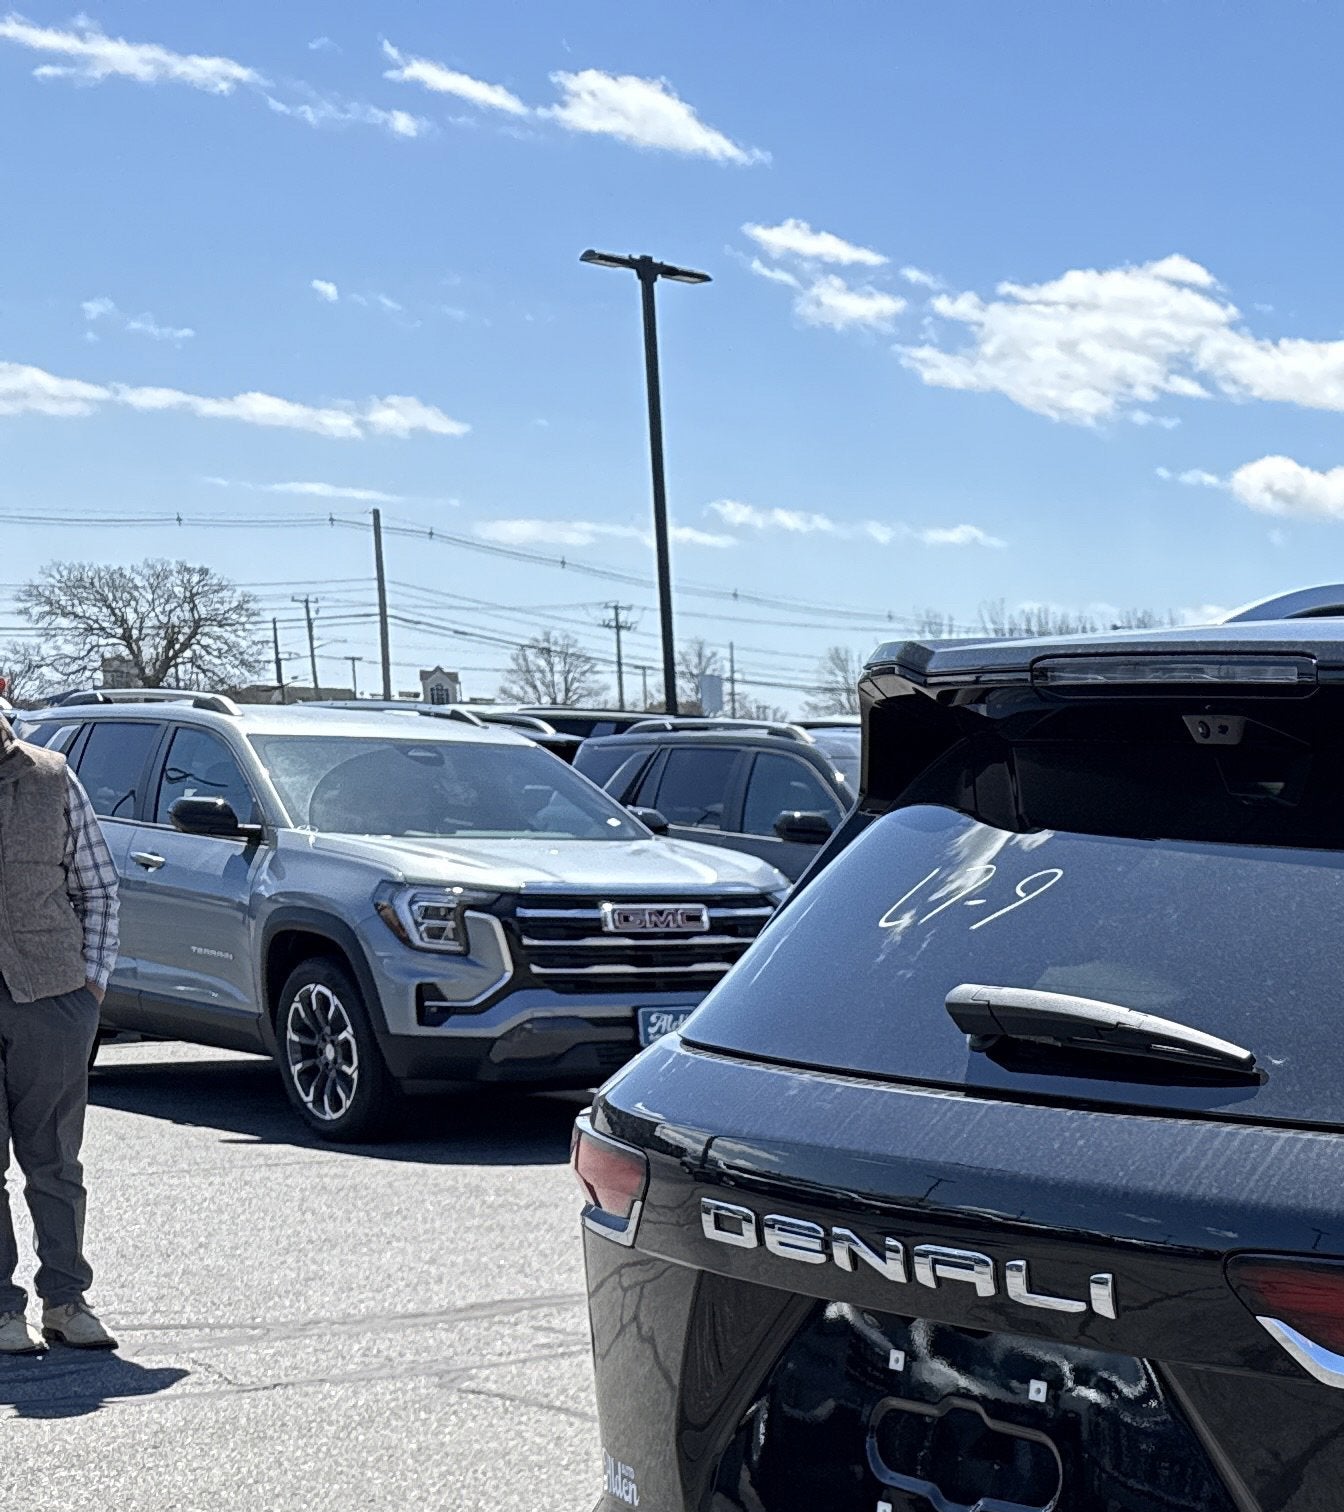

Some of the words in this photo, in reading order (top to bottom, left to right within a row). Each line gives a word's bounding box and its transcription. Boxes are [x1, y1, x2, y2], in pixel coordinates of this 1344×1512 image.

[613, 908, 703, 929] GMC
[647, 1012, 690, 1034] Ald
[701, 1197, 1118, 1320] DENALI
